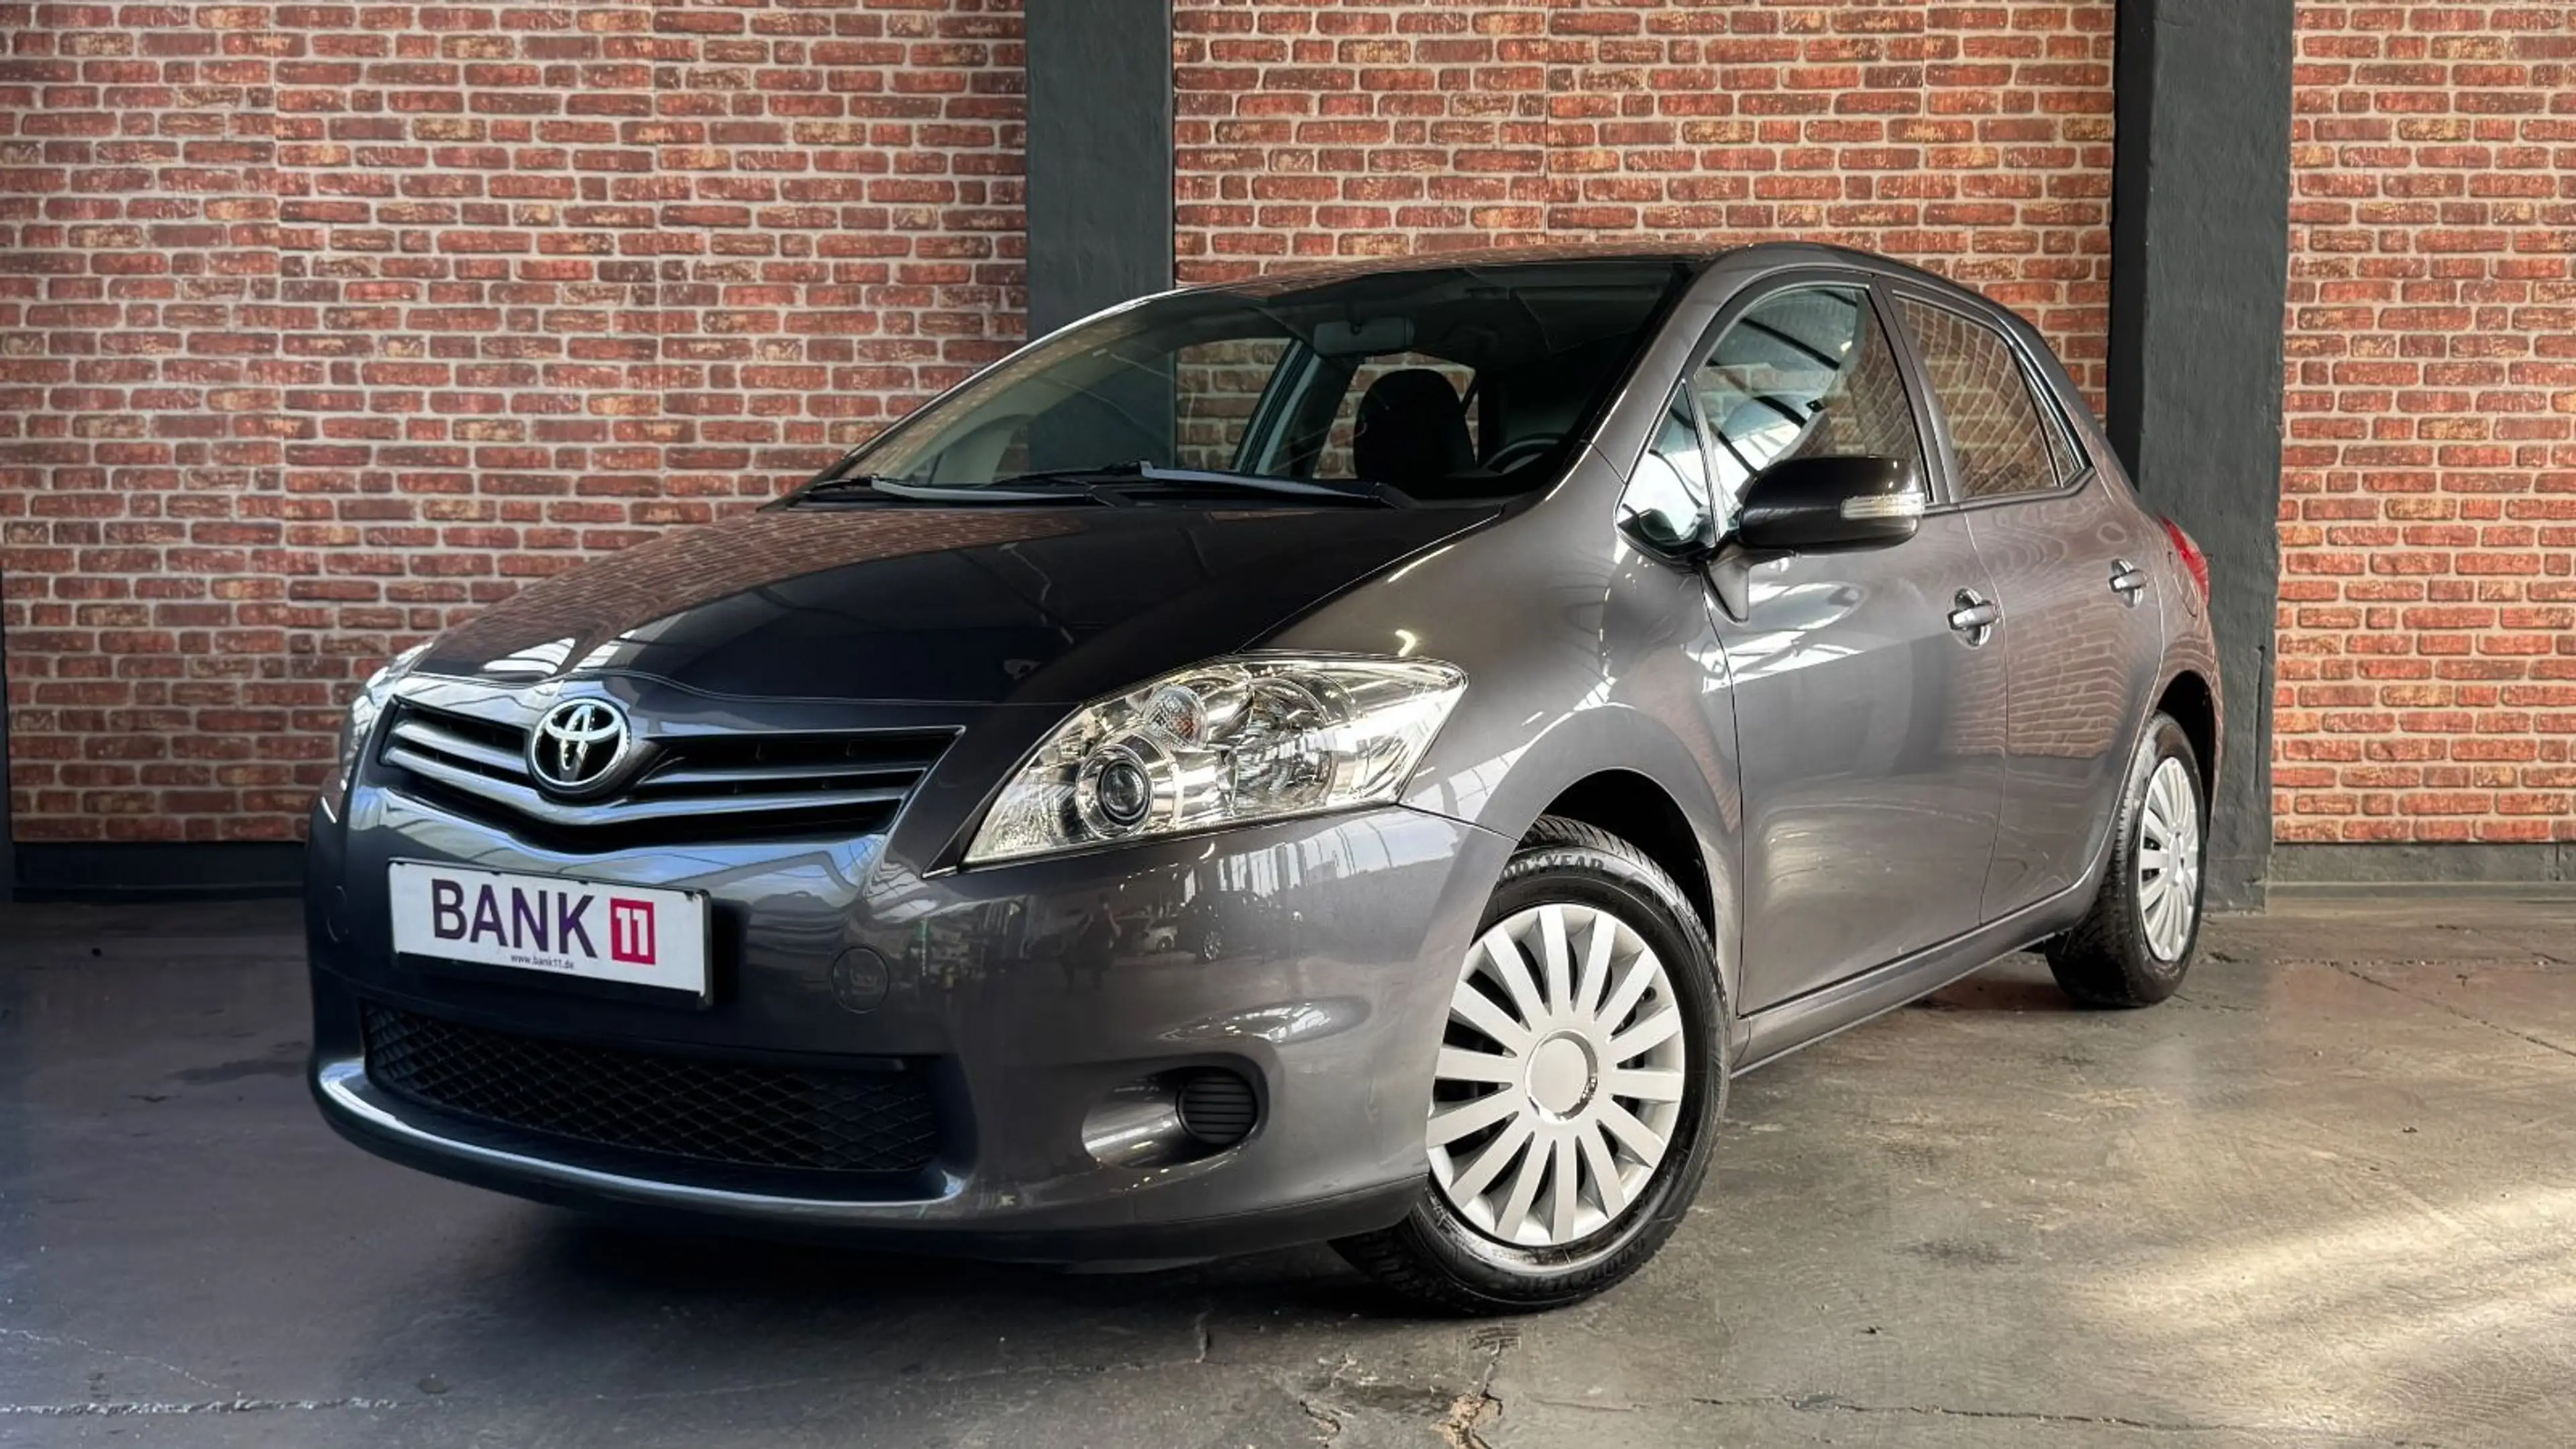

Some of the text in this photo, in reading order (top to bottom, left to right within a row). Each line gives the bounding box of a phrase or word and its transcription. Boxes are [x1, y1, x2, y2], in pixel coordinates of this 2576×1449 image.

[432, 879, 649, 958] BANK 11
[511, 955, 574, 969] www.bank11.de
